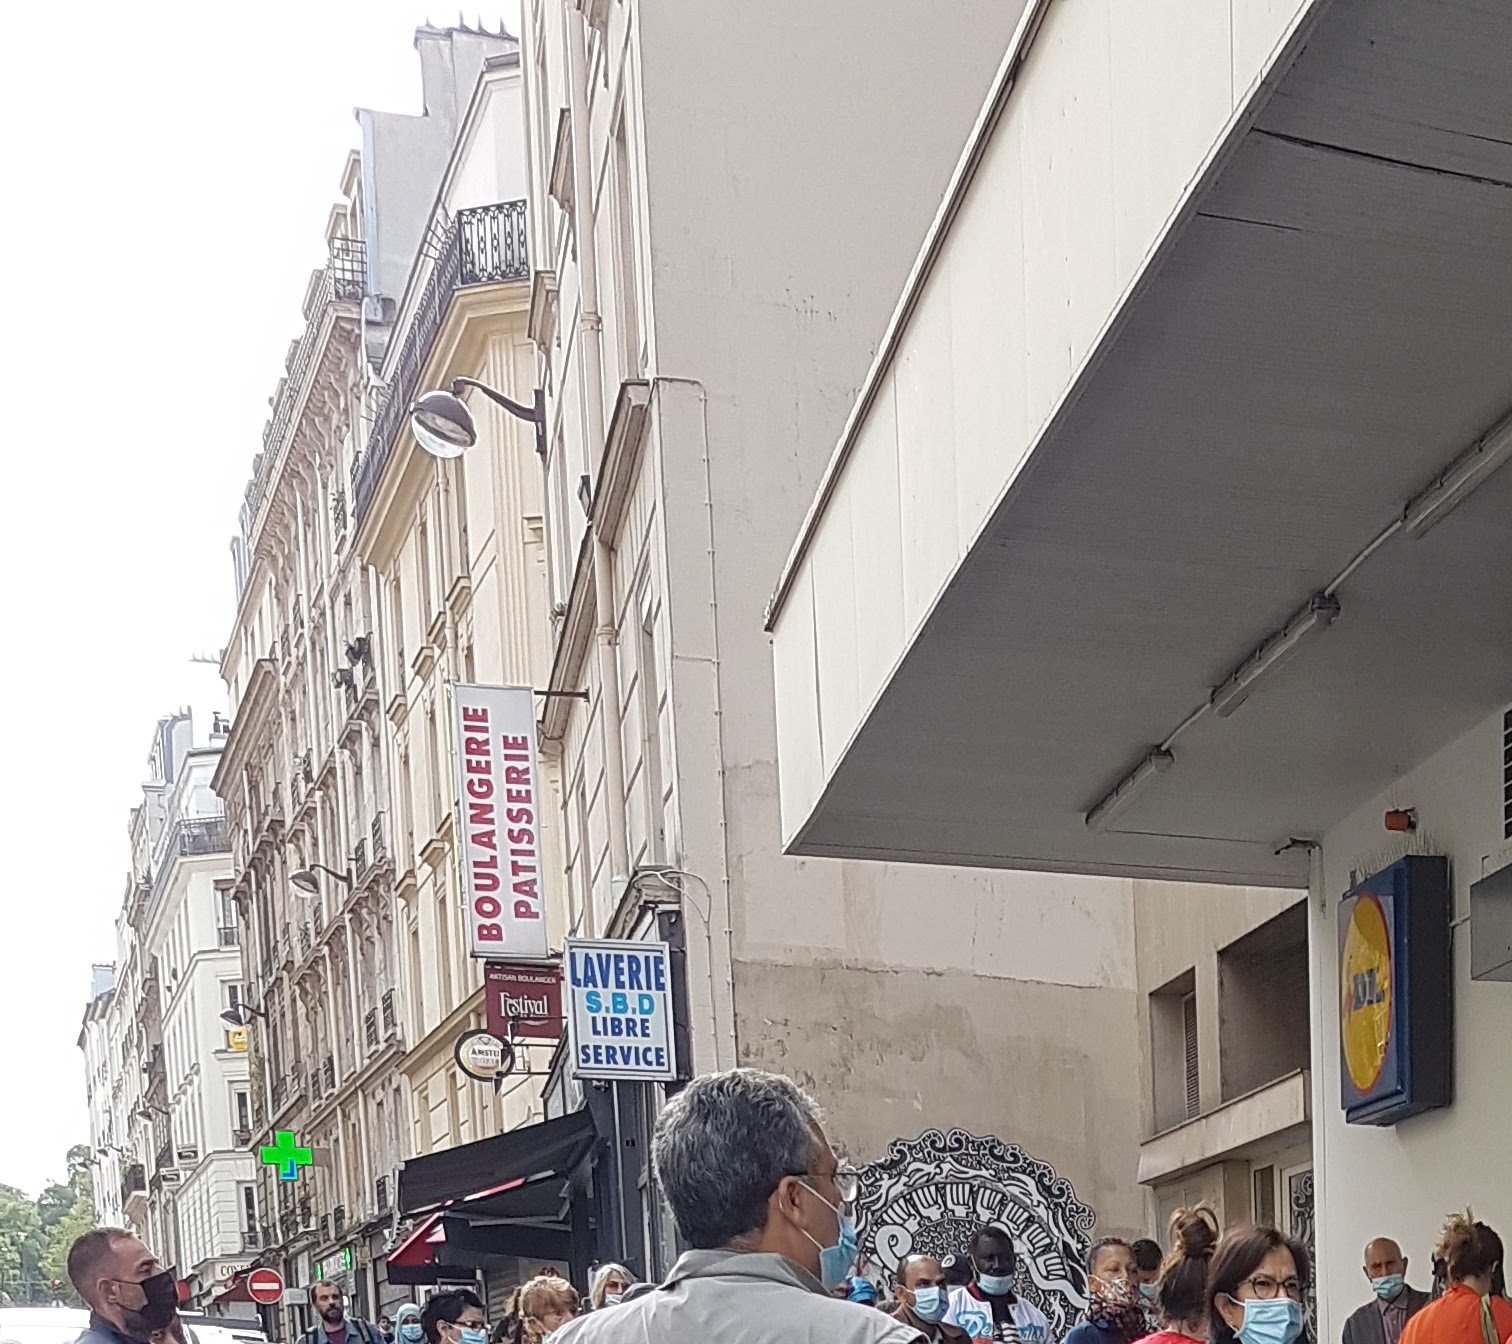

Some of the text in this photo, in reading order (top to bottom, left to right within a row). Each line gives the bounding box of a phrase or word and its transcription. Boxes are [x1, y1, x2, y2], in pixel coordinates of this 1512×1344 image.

[463, 707, 503, 941] BOULANGERIE
[503, 735, 539, 918] PATISSERIE
[570, 952, 665, 991] LAVERIE
[500, 992, 547, 1017] Festival
[586, 991, 654, 1015] S.B.D
[592, 1016, 650, 1037] LIBRE
[581, 1044, 665, 1066] SERVICE
